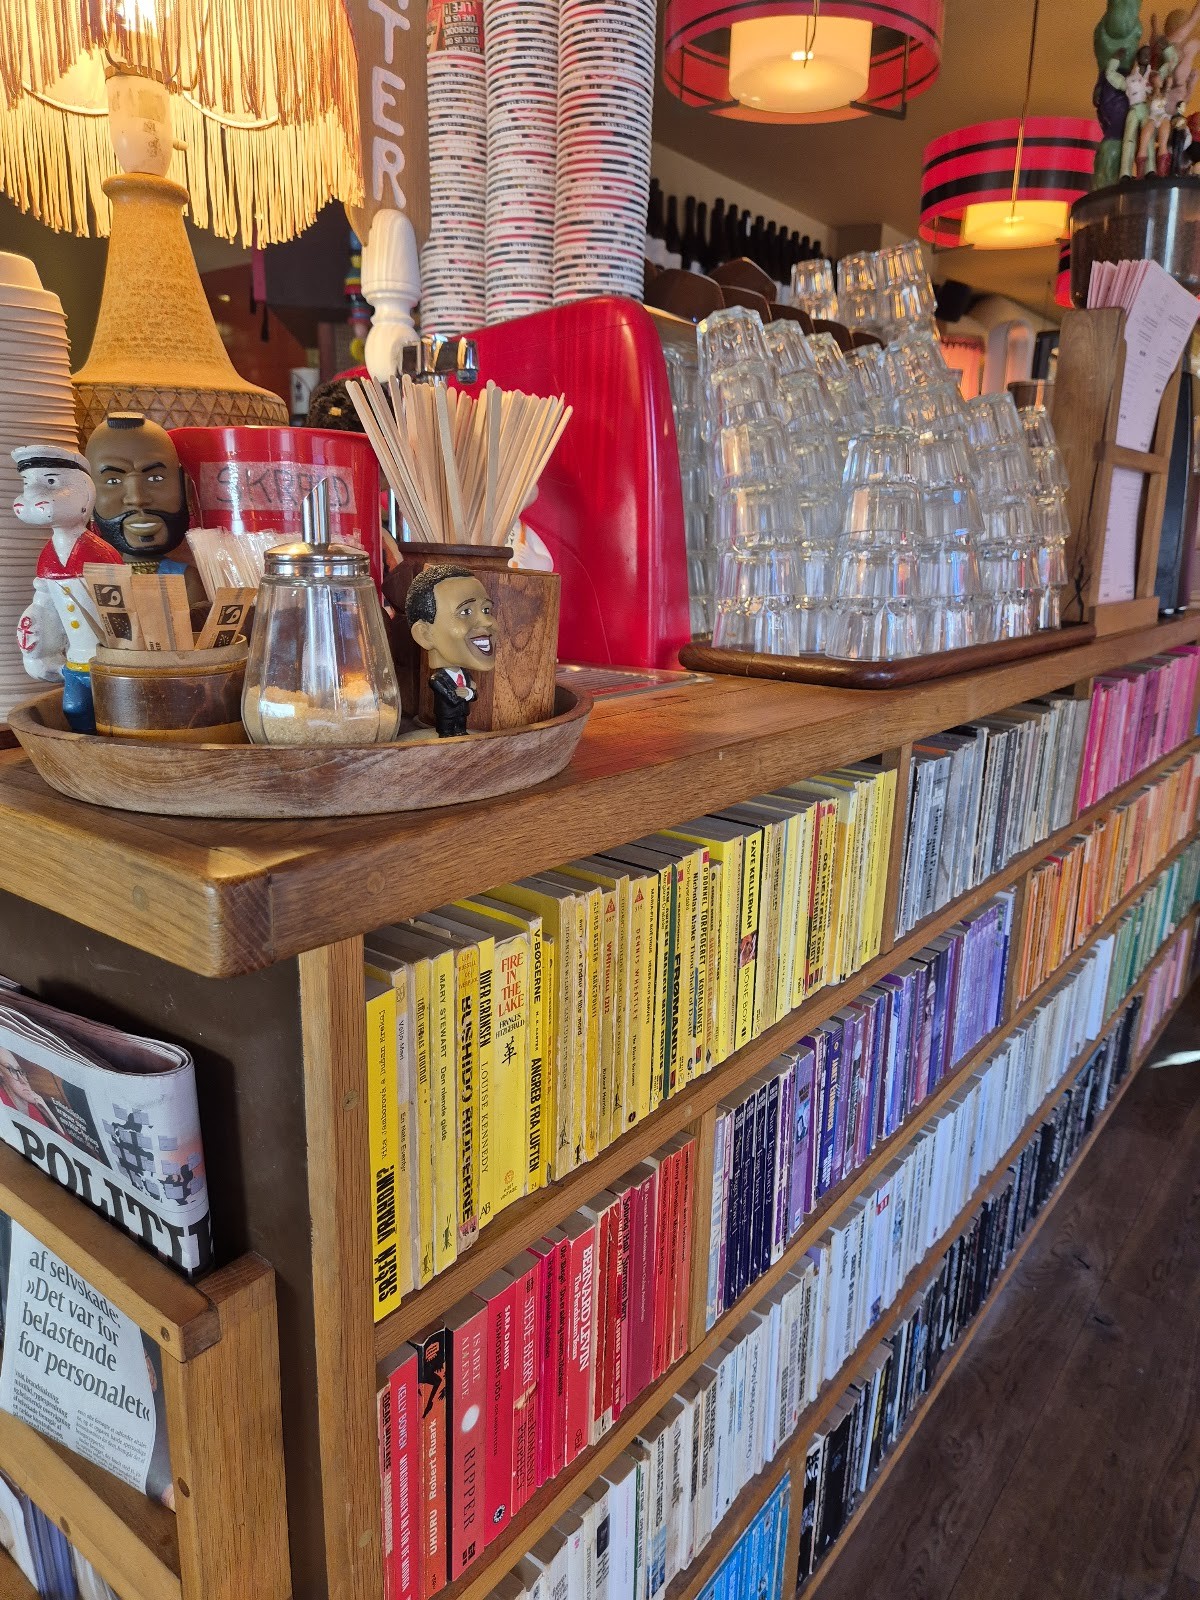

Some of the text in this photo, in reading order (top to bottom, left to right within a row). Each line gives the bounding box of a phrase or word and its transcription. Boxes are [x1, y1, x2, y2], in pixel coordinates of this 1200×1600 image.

[216, 466, 350, 508] SKRAD
[749, 838, 757, 864] FAYE
[701, 866, 709, 906] O'DONNEL
[745, 866, 756, 930] KELLERMAN
[700, 909, 708, 965] TORPEDERET
[501, 951, 525, 973] FIRE
[505, 969, 518, 986] IN
[605, 941, 613, 993] WHITEHALL
[497, 994, 525, 1018] LAKE
[501, 982, 523, 999] THE
[632, 968, 640, 1021] WHEATLEY
[671, 953, 681, 1067] FRØMAND!
[688, 997, 694, 1007] of
[495, 1019, 526, 1040] FITZGERALD
[499, 1013, 522, 1029] FRANCES
[576, 1015, 584, 1036] mord
[438, 974, 448, 1141] MARY STEWART Den niende gåde
[479, 969, 494, 1174] ÖVER GRÄNSEN LOUISE KENNEDY
[529, 928, 543, 1173] V-BØGERNE ANGREB FRA LUFTEN
[830, 1058, 839, 1083] JANET
[826, 1084, 837, 1131] EVANOVICH
[375, 1165, 397, 1246] VRAHOM?
[29, 1250, 48, 1273] af
[620, 1196, 631, 1323] Solveig Hall Stormens barn
[26, 1276, 120, 1348] »Det var for
[523, 1295, 535, 1340] STEVE
[572, 1291, 580, 1338] Pendulum
[579, 1244, 593, 1371] BERNARD LEVIN
[22, 1301, 117, 1372] belastende
[494, 1311, 502, 1378] HUSMODERNS
[503, 1304, 511, 1370] SARA DANIUS
[17, 1330, 45, 1363] for
[44, 1351, 151, 1422] personalet«
[461, 1336, 470, 1400] ALLENDE
[522, 1340, 534, 1386] BERRY
[382, 1390, 391, 1426] EDGAR
[397, 1383, 407, 1414] KELLY
[494, 1381, 502, 1402] DÖD
[382, 1424, 392, 1472] WALLACE
[398, 1412, 408, 1451] BOWEN
[463, 1332, 481, 1532] ISABEL RIPPER
[526, 1422, 537, 1488] ROMANOV
[515, 1425, 527, 1492] PROPHECY
[428, 1418, 438, 1556] UHURU Robert Ruark
